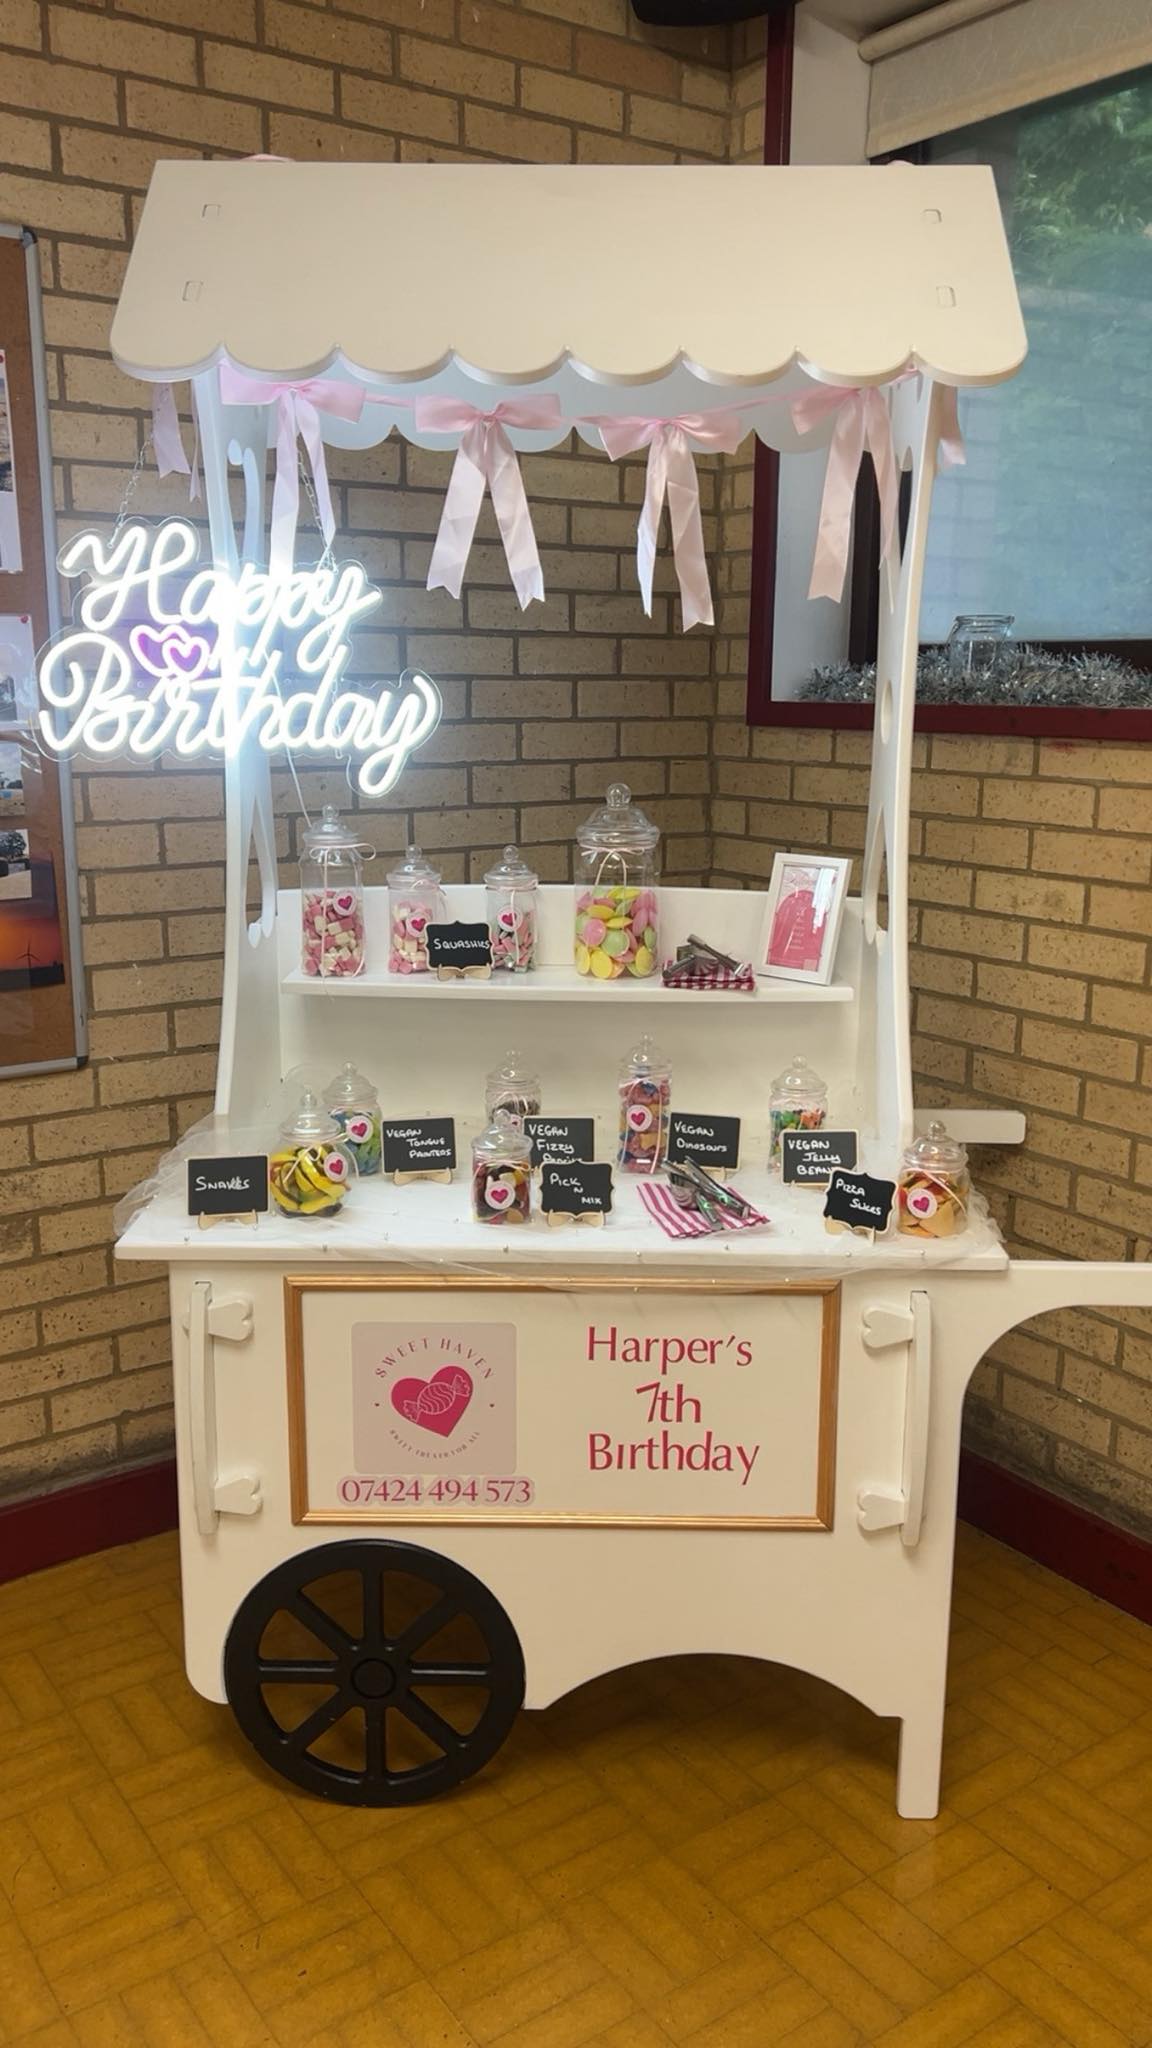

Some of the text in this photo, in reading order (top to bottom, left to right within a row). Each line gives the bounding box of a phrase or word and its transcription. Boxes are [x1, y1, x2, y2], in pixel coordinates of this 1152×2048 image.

[61, 521, 383, 672] Happy
[38, 632, 438, 796] Birthday
[528, 1124, 568, 1136] VEGAN
[788, 1139, 830, 1150] VEGAN
[796, 1165, 833, 1175] BEAN
[835, 1178, 866, 1196] PIZZA
[581, 1196, 603, 1205] MIX
[375, 1337, 494, 1379] SWEET HAVEN
[635, 1381, 702, 1423] 7th
[588, 1429, 761, 1486] Birthday
[341, 1478, 532, 1503] 07424 494 573
